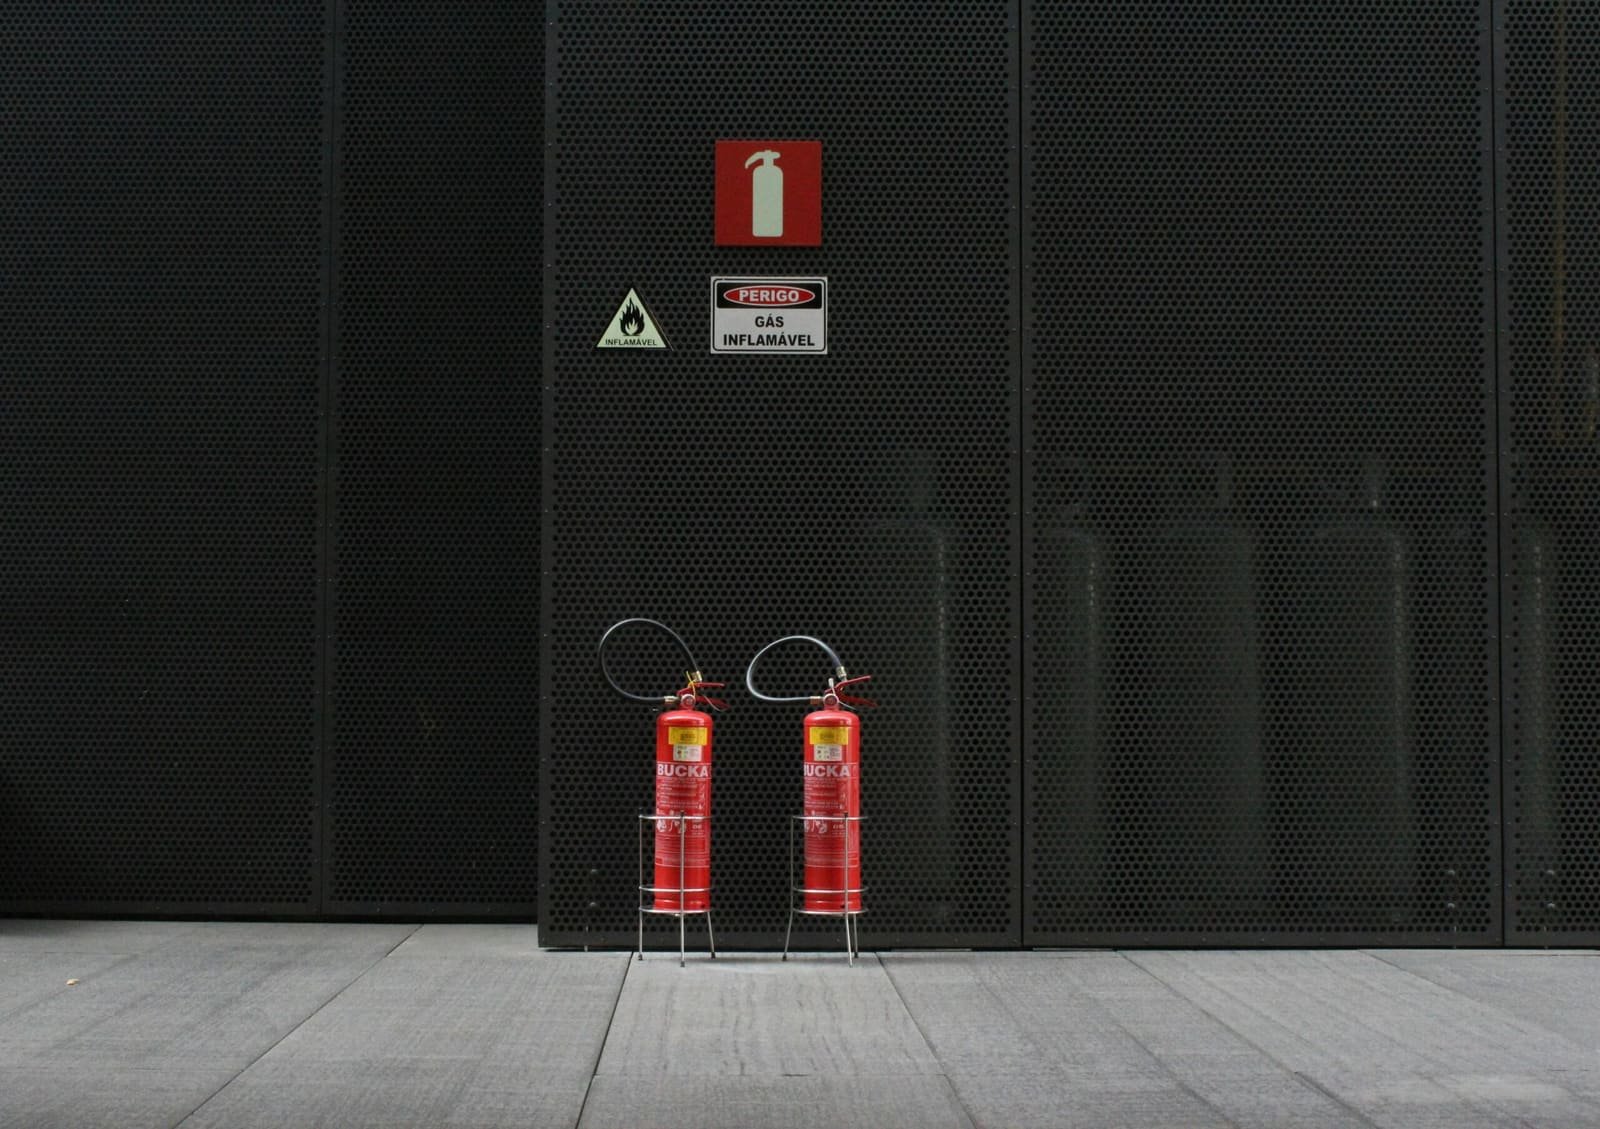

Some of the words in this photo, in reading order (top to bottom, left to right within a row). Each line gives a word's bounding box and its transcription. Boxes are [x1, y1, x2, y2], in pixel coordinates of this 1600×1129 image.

[738, 289, 800, 302] PERIGO
[754, 313, 784, 328] GÁS
[605, 338, 658, 346] INFLAMÁVEL
[723, 332, 815, 346] INFLAMÁVEL
[657, 763, 709, 777] BUCKA
